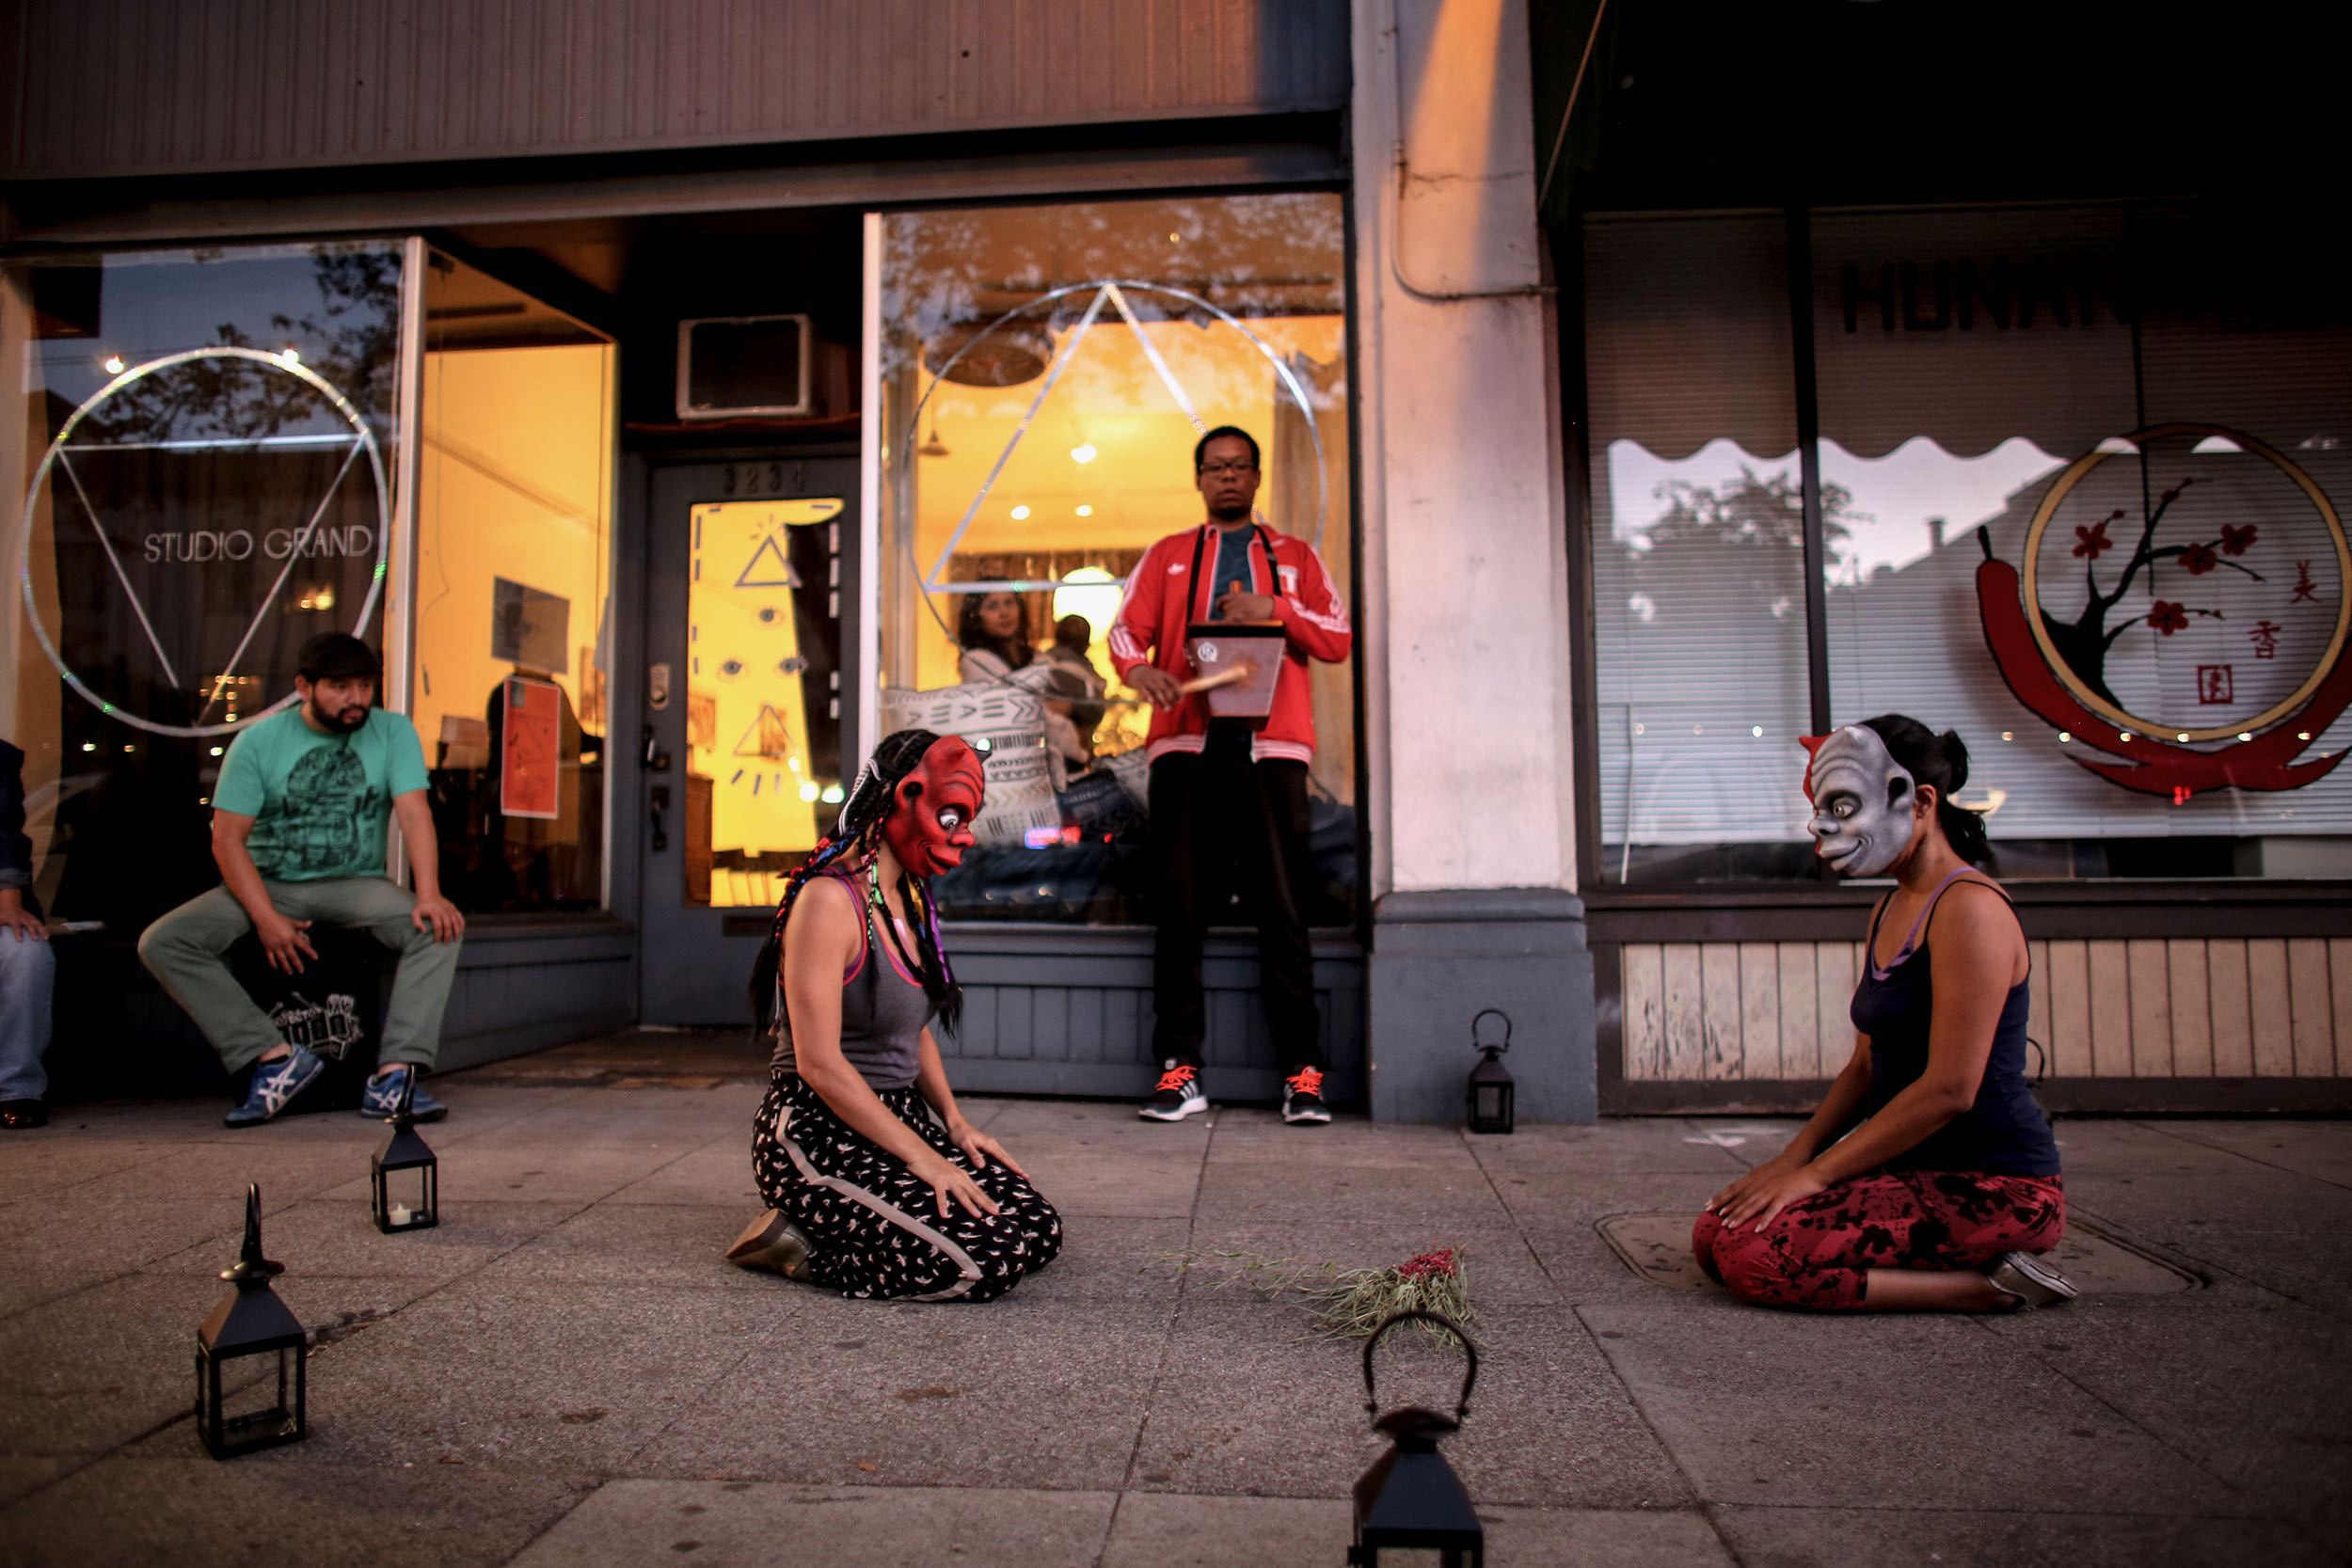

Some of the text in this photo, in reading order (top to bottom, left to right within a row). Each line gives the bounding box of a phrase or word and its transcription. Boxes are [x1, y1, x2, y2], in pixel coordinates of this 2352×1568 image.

[1841, 259, 2137, 331] HUNAN
[144, 525, 373, 562] STUDIO GRAND
